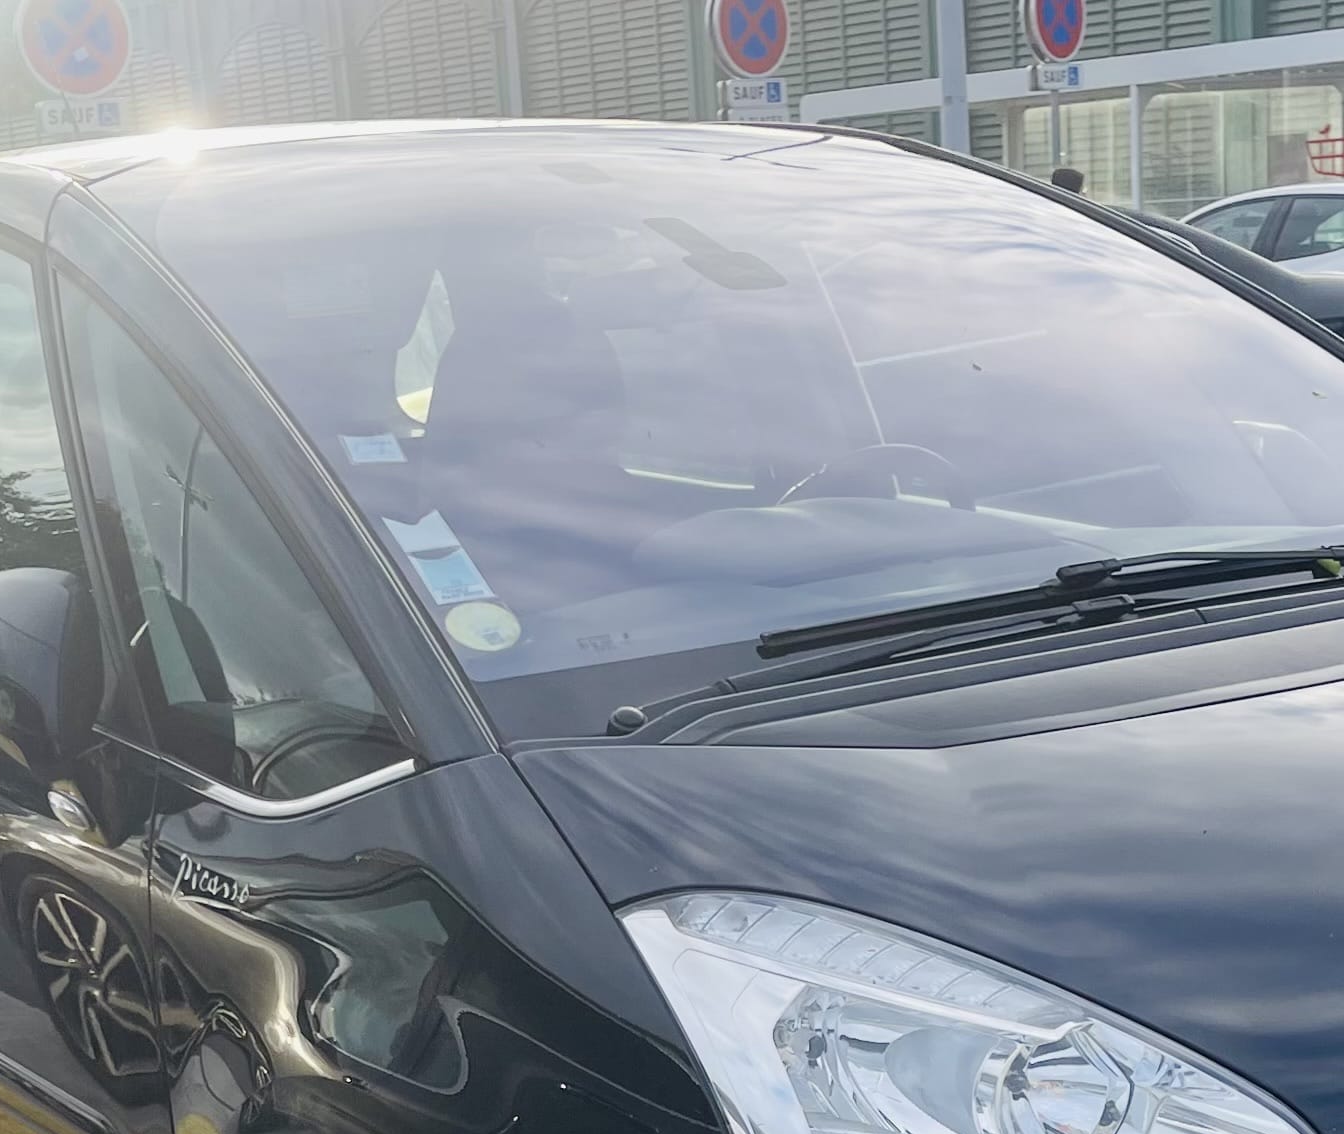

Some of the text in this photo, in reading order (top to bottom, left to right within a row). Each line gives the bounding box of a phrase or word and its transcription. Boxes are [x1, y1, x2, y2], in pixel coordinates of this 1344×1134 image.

[1043, 70, 1066, 83] SAUF
[733, 85, 764, 100] SAUF
[47, 106, 95, 126] SAUF
[169, 852, 251, 904] Picasso
